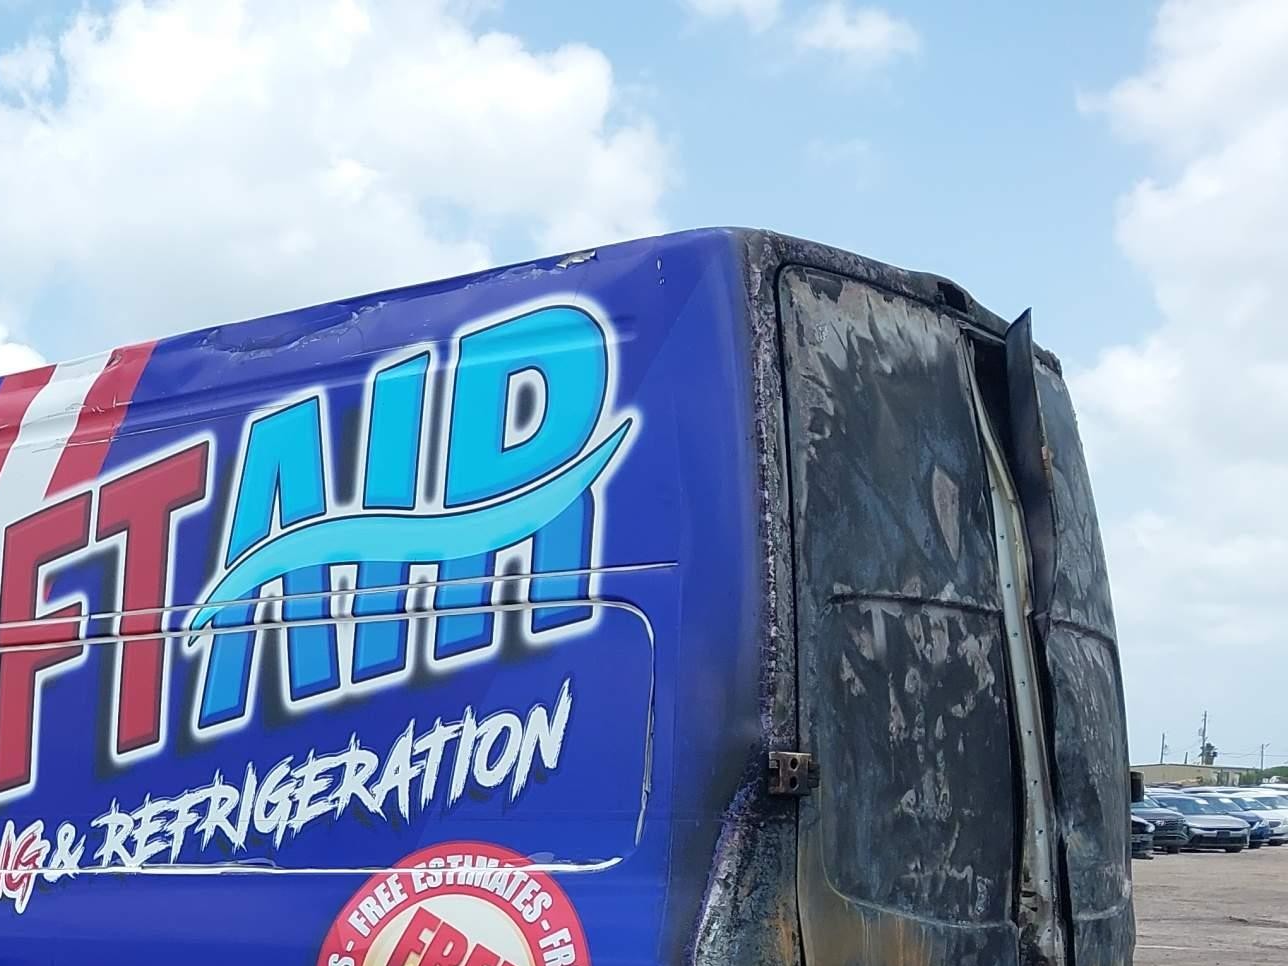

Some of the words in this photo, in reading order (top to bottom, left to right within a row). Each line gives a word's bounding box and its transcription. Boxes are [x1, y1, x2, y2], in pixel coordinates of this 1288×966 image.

[43, 822, 86, 882] &
[90, 677, 573, 870] REFRIGERATION
[348, 874, 409, 938] FREE
[412, 855, 554, 923] ESTIMATES
